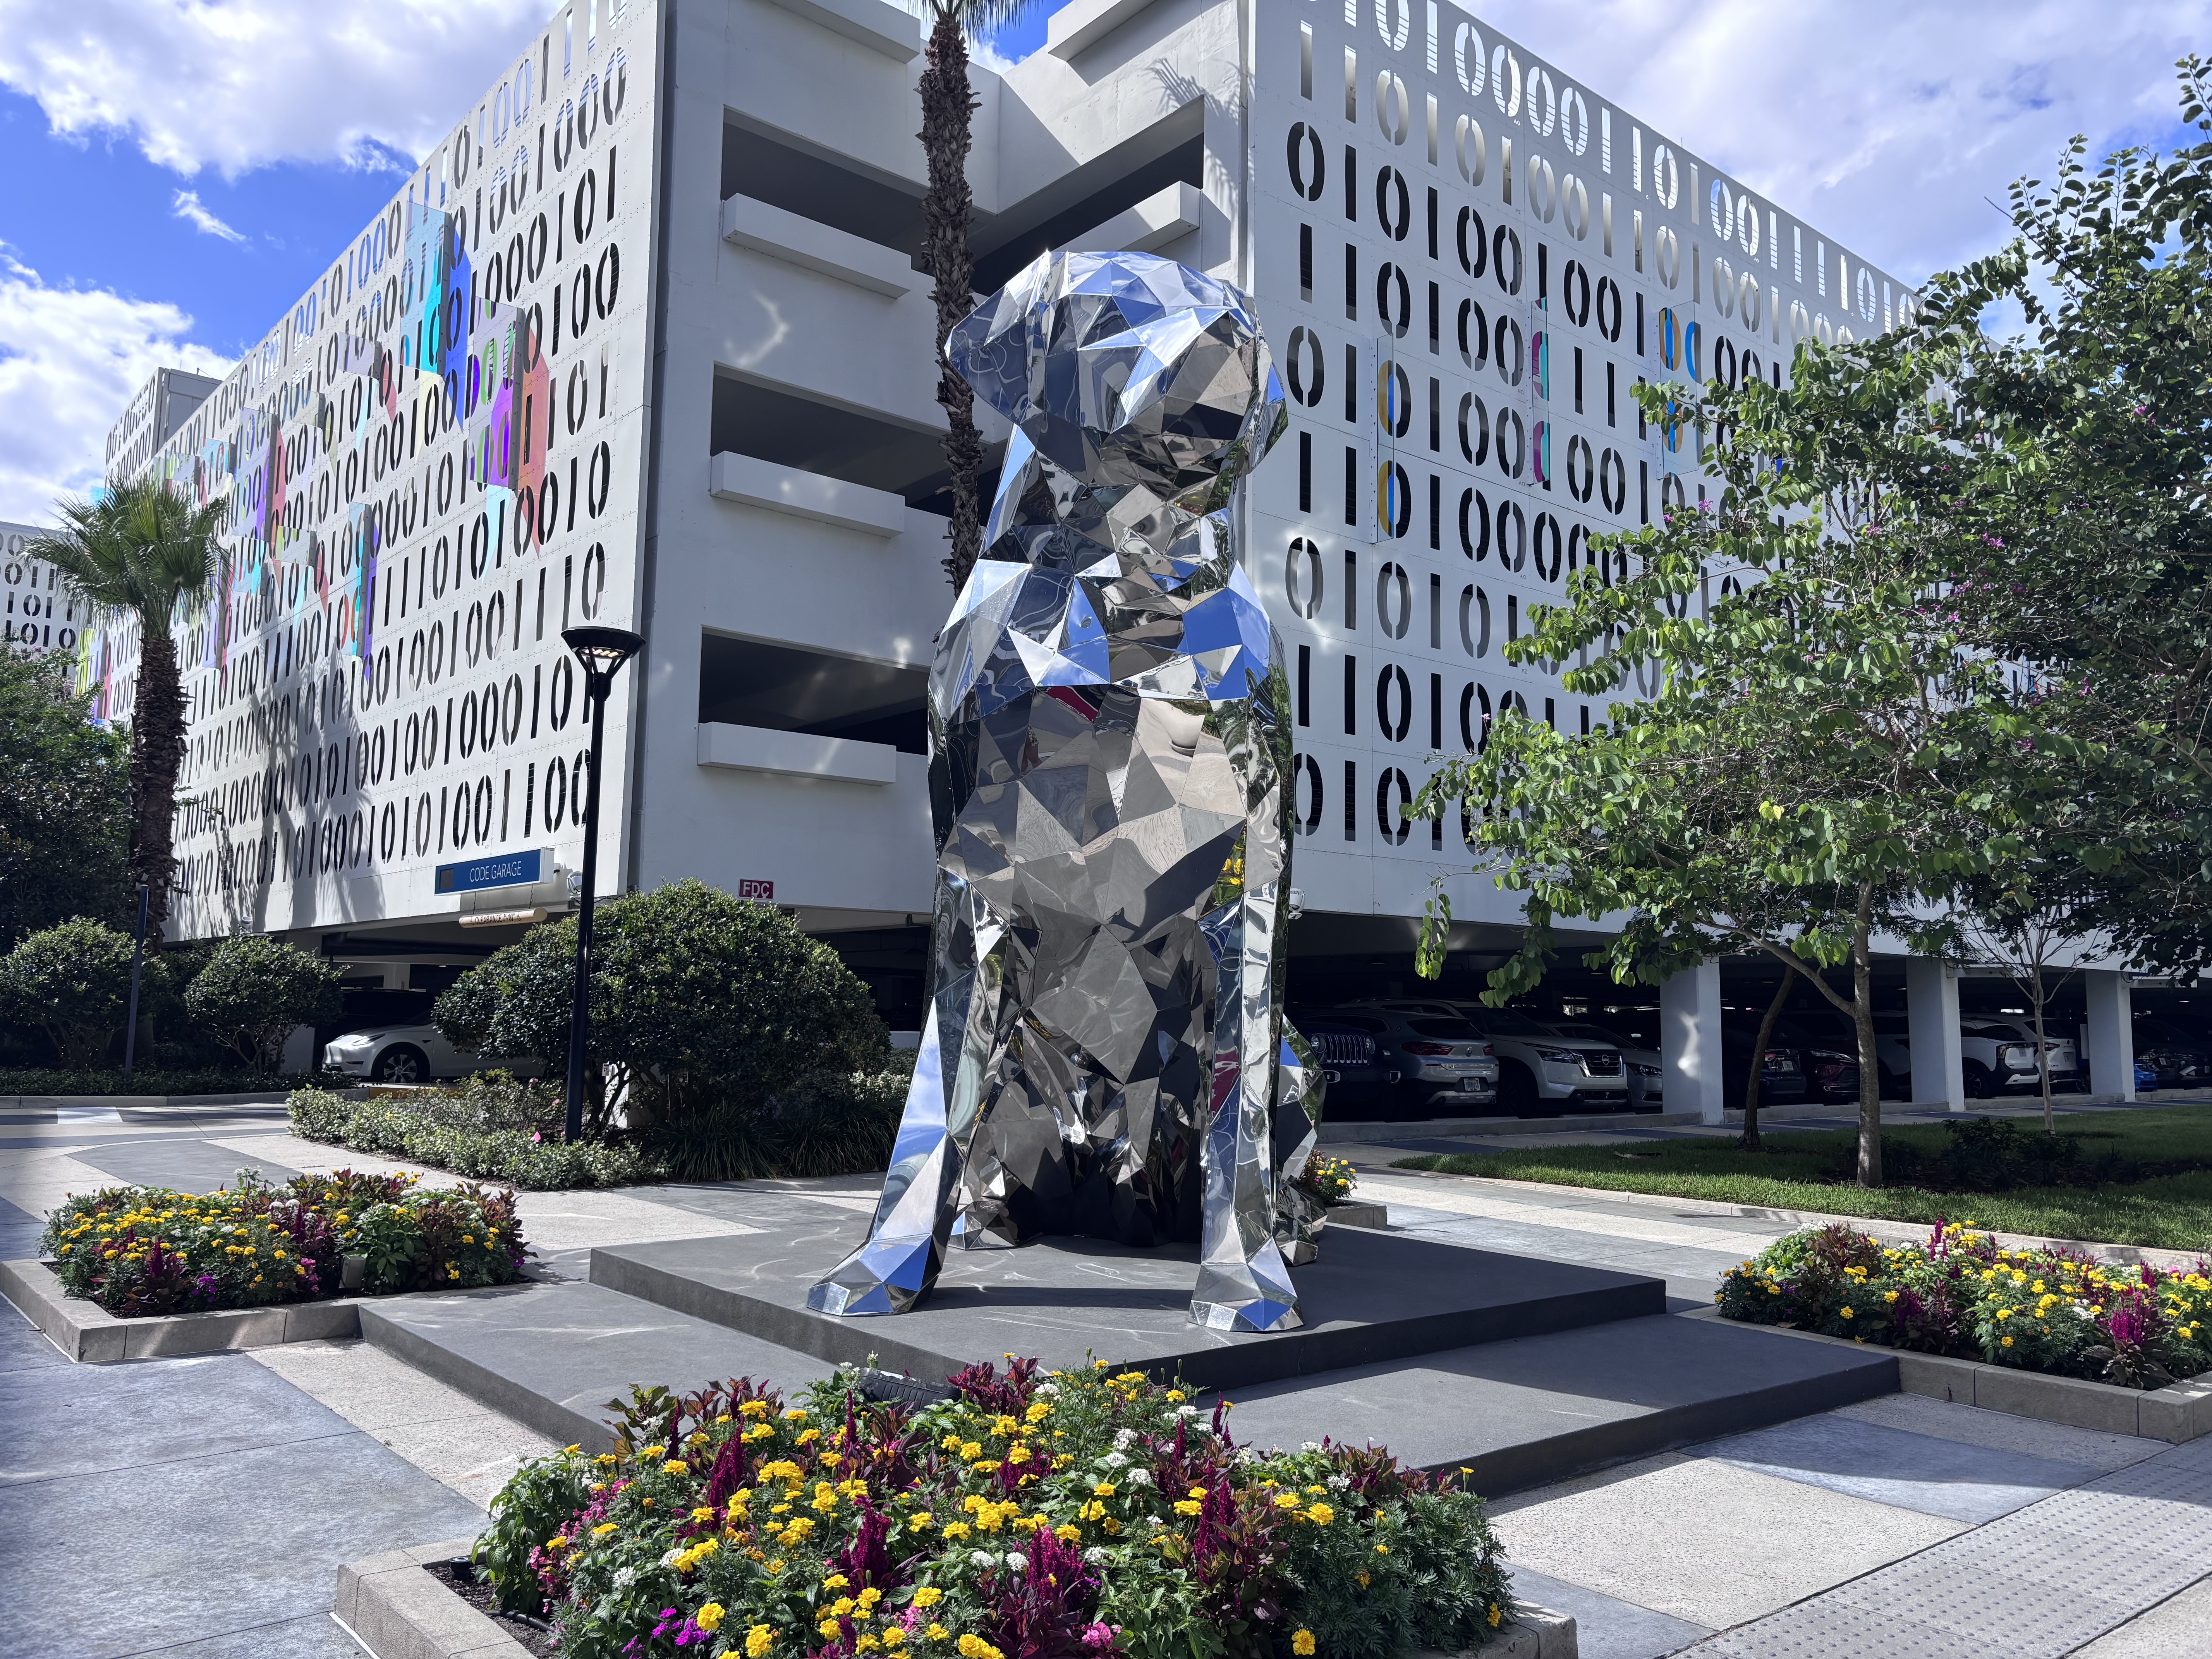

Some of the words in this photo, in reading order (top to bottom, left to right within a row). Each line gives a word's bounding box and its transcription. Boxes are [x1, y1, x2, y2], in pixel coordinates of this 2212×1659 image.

[470, 866, 489, 883] CODE
[491, 861, 522, 879] GARAGE
[743, 882, 769, 896] FDC
[475, 914, 501, 925] CLEARANCE
